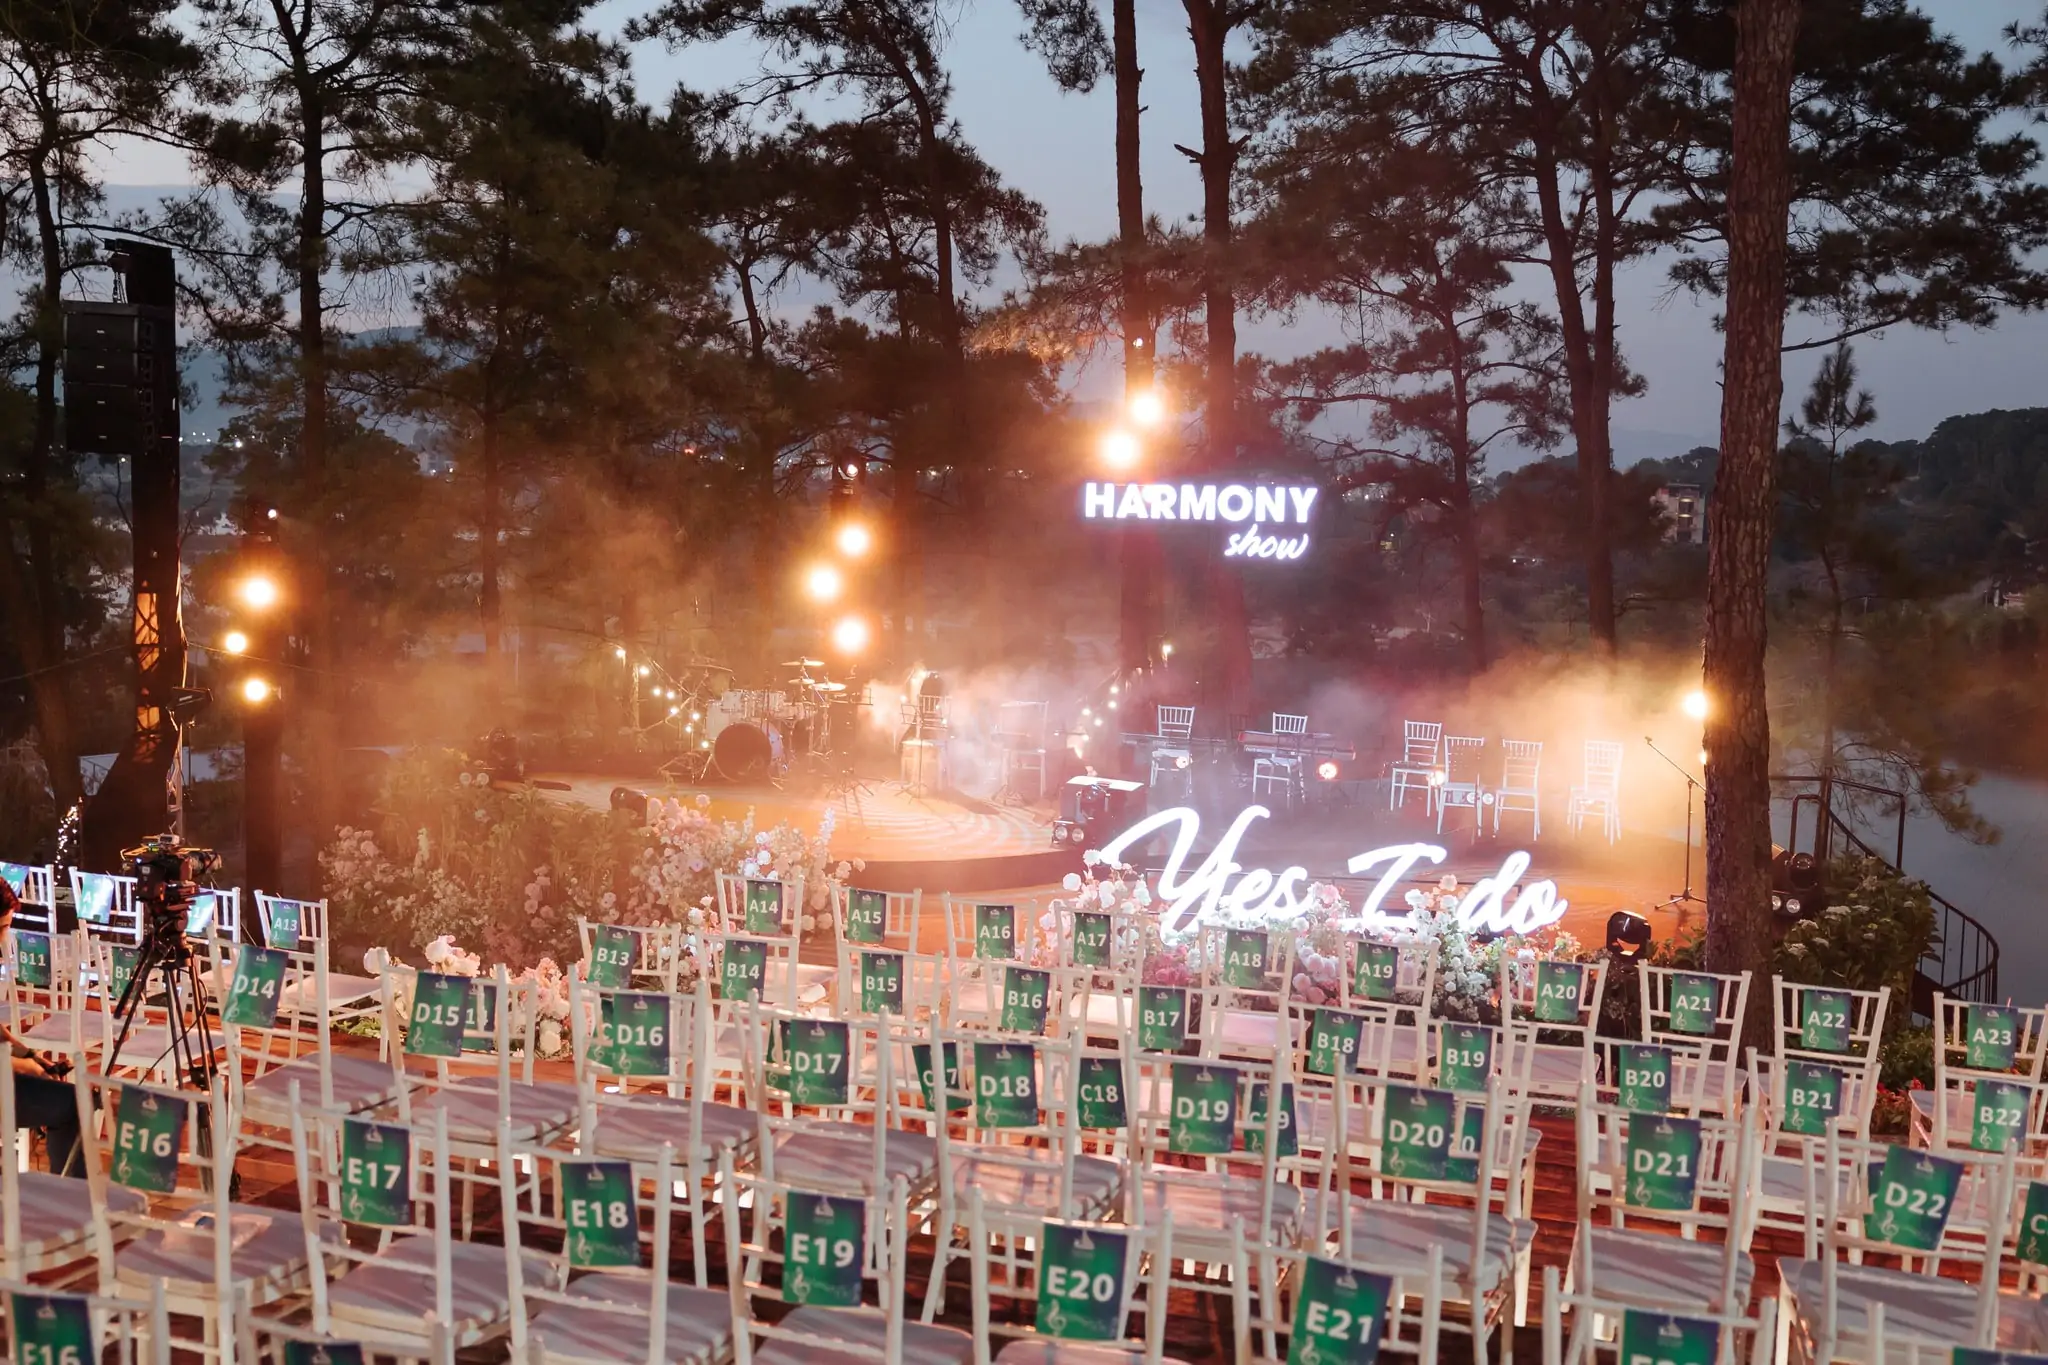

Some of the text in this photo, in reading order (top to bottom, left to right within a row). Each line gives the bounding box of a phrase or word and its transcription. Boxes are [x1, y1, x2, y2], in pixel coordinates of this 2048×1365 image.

[1085, 482, 1318, 523] HARMONY
[1224, 524, 1309, 560] show
[1099, 805, 1568, 943] Yes I do
[750, 899, 779, 914] A14
[851, 908, 881, 924] A15
[274, 917, 297, 931] A13
[979, 925, 1011, 940] A16
[1076, 932, 1106, 947] A17
[20, 950, 46, 967] B11
[596, 948, 629, 966] B13
[1228, 952, 1262, 968] A18
[115, 966, 134, 981] B1
[726, 963, 760, 980] B14
[1359, 963, 1393, 979] A19
[234, 975, 275, 999] D14
[865, 976, 898, 993] B15
[1541, 983, 1577, 1000] A20
[1007, 990, 1042, 1009] B16
[1675, 994, 1712, 1012] A21
[415, 1003, 461, 1027] D15
[1143, 1009, 1179, 1028] B17
[1807, 1010, 1846, 1029] A22
[617, 1024, 664, 1047] D16
[1317, 1032, 1354, 1054] B18
[1972, 1027, 2012, 1046] A23
[794, 1052, 842, 1075] D17
[1446, 1050, 1485, 1068] B19
[923, 1068, 958, 1087] C7
[980, 1075, 1031, 1098] D18
[1625, 1068, 1666, 1088] B20
[1080, 1083, 1119, 1103] C18
[1791, 1089, 1833, 1111] B21
[1176, 1096, 1230, 1123] D19
[1979, 1107, 2021, 1128] B22
[119, 1122, 172, 1158] E16
[1388, 1118, 1444, 1148] D20
[1633, 1149, 1690, 1178] D21
[346, 1158, 401, 1190] E17
[1884, 1181, 1946, 1219] D22
[570, 1199, 629, 1229] E18
[790, 1232, 855, 1267] E19
[1046, 1265, 1116, 1302] E20
[1305, 1300, 1374, 1345] E21
